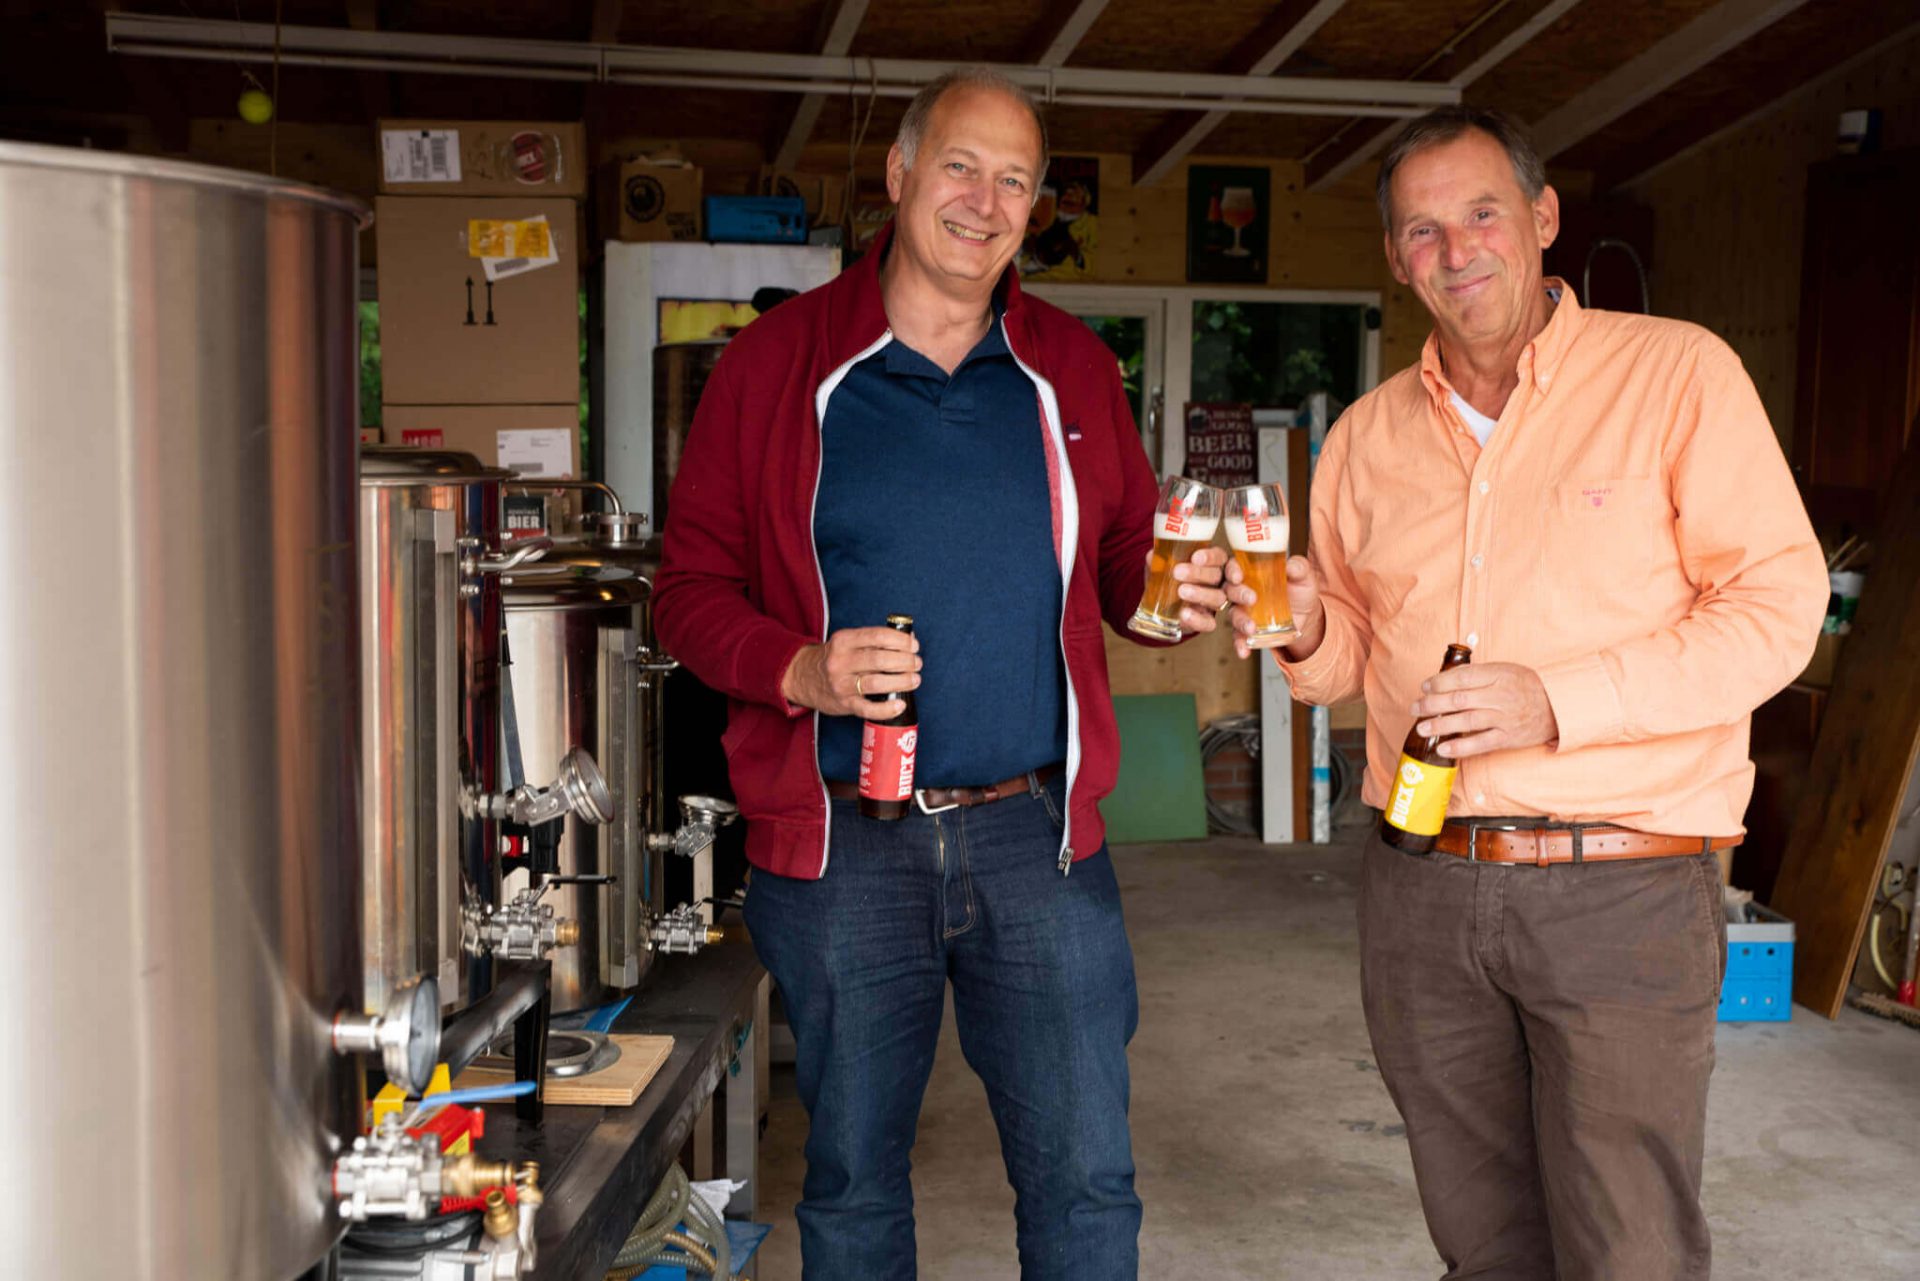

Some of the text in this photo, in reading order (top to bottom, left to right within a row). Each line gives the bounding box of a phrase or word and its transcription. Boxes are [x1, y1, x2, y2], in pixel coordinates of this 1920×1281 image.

[1189, 434, 1251, 453] BEER
[1208, 455, 1252, 470] GOOD
[508, 516, 540, 528] BIER
[1165, 496, 1184, 534] BUCK
[898, 753, 915, 797] BUCK
[1390, 783, 1415, 826] BUCK
